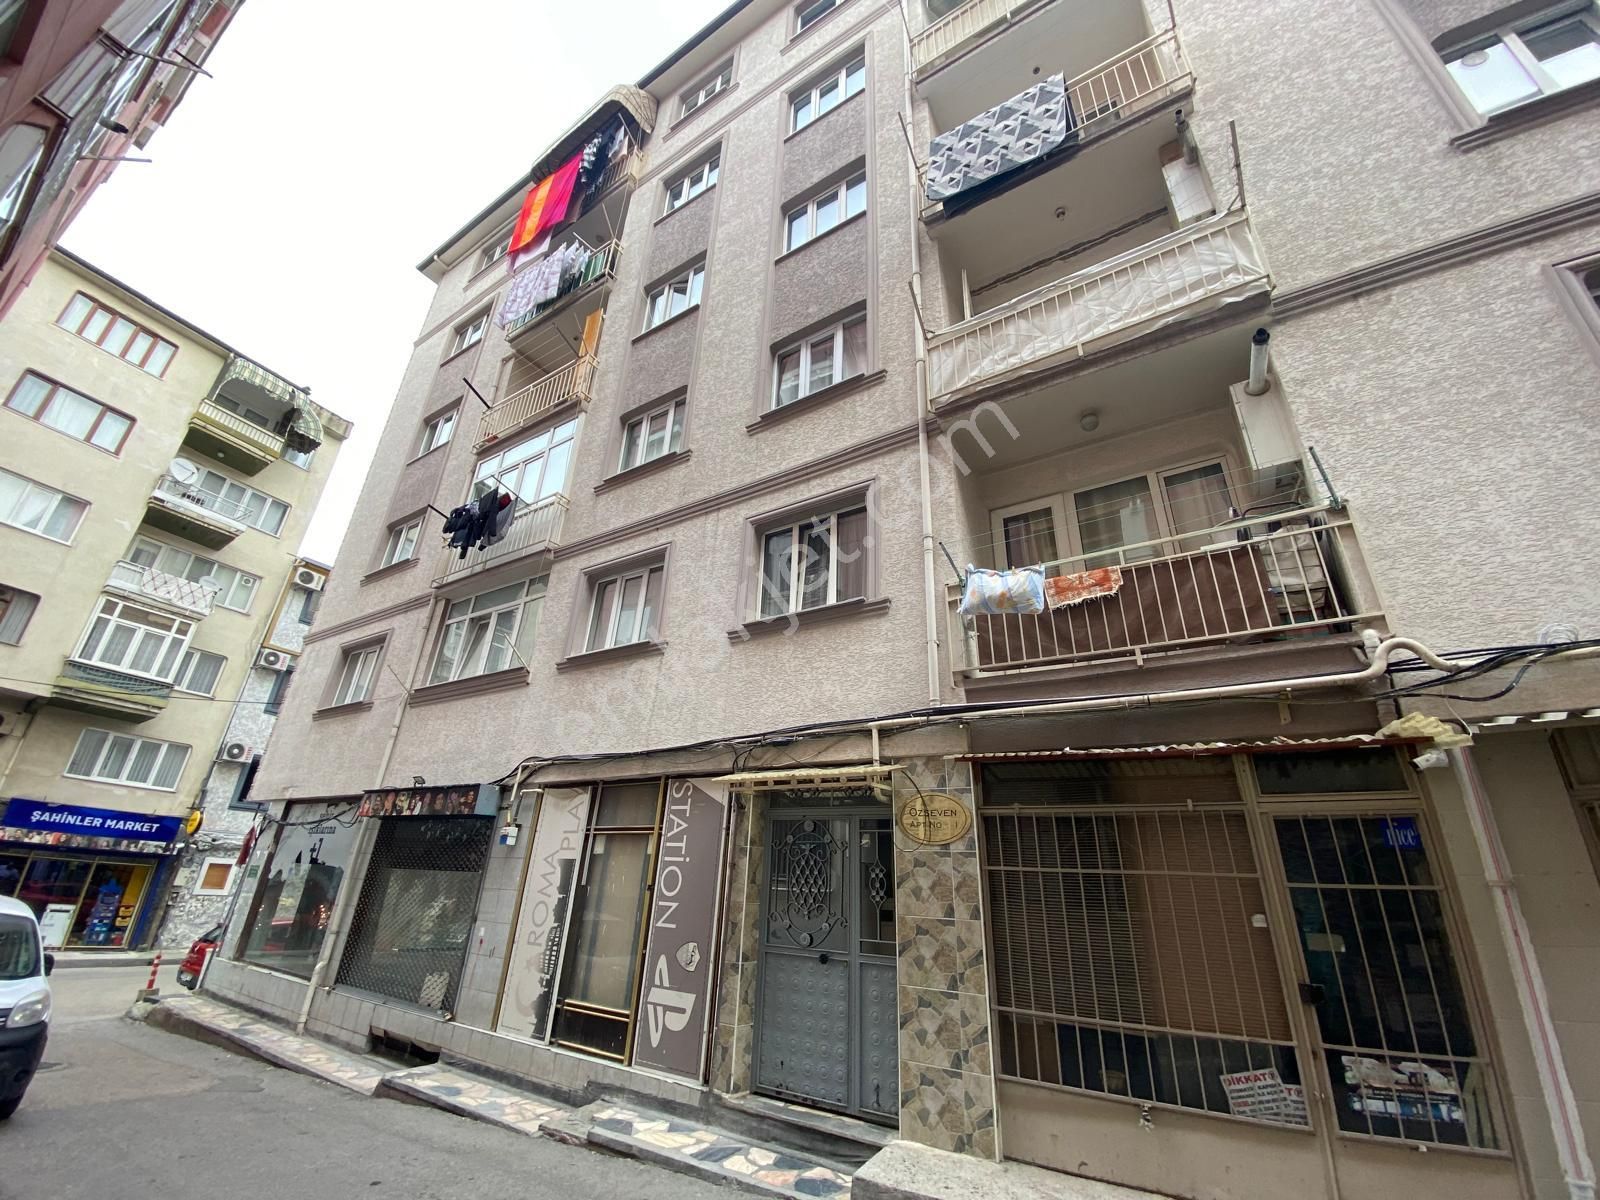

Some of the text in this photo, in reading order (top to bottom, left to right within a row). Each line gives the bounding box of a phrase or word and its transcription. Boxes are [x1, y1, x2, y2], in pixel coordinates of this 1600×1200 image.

[31, 811, 160, 833] ŞAHİNLER MARKET
[560, 788, 589, 851] PLAY
[527, 850, 560, 947] ROMA
